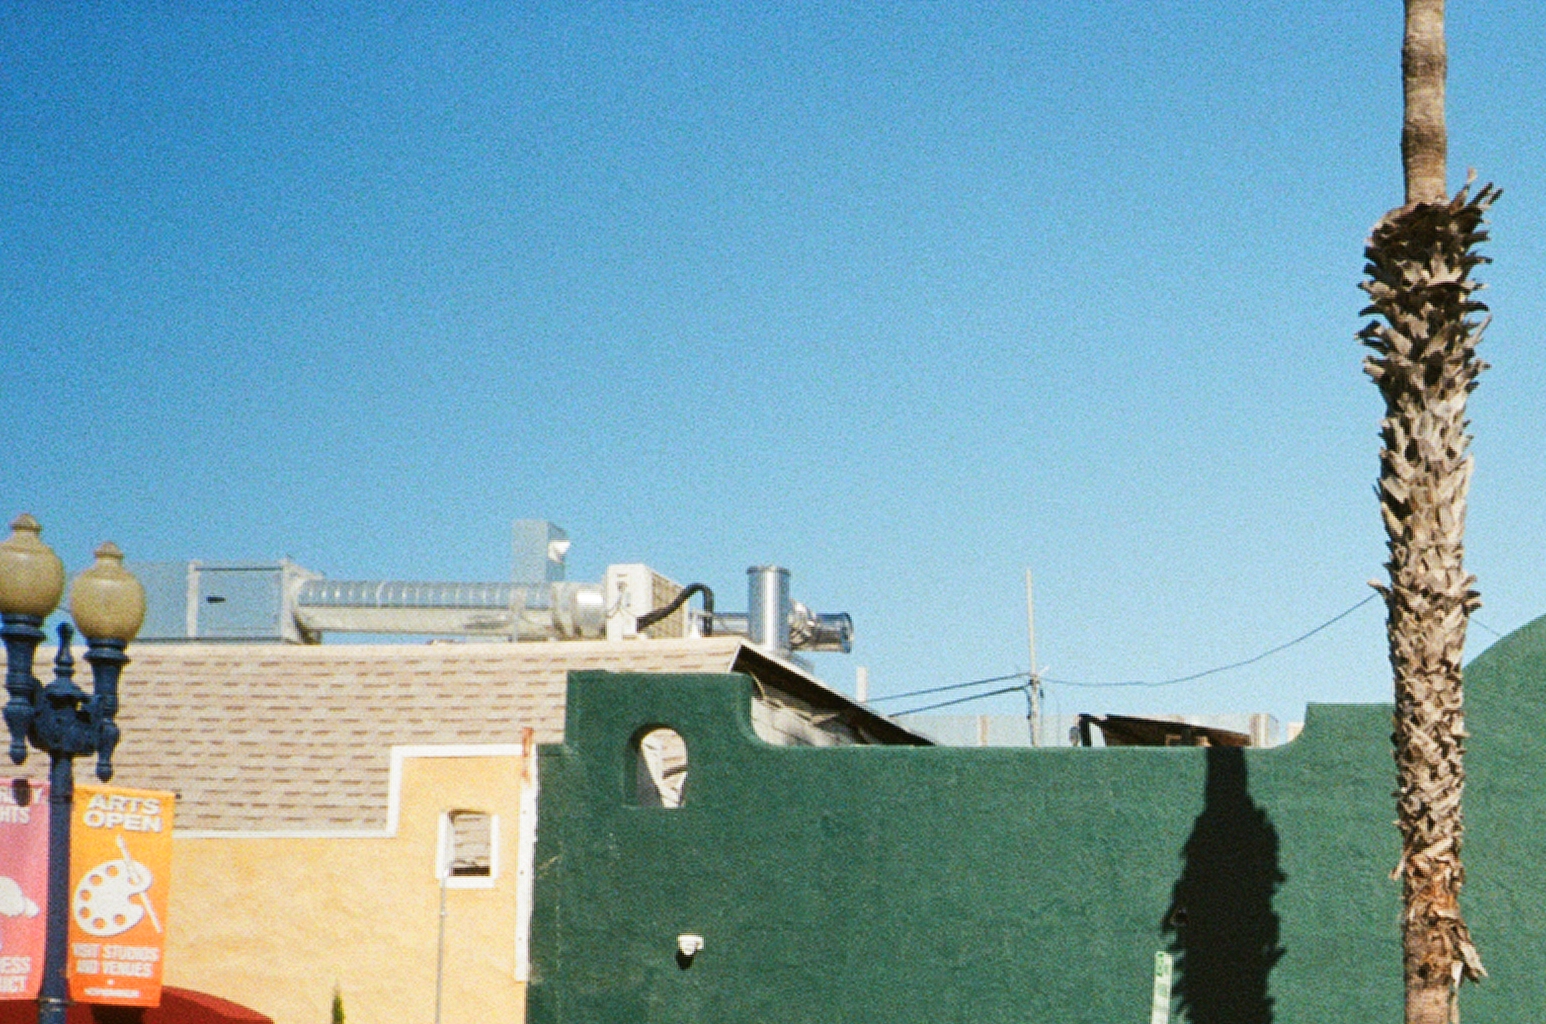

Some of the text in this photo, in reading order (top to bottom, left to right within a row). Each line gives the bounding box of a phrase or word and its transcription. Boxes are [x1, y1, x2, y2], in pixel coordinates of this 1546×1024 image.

[87, 793, 161, 816] ARTS
[83, 809, 163, 833] OPEN
[103, 945, 160, 962] STUDIOS
[103, 960, 153, 978] VENUES
